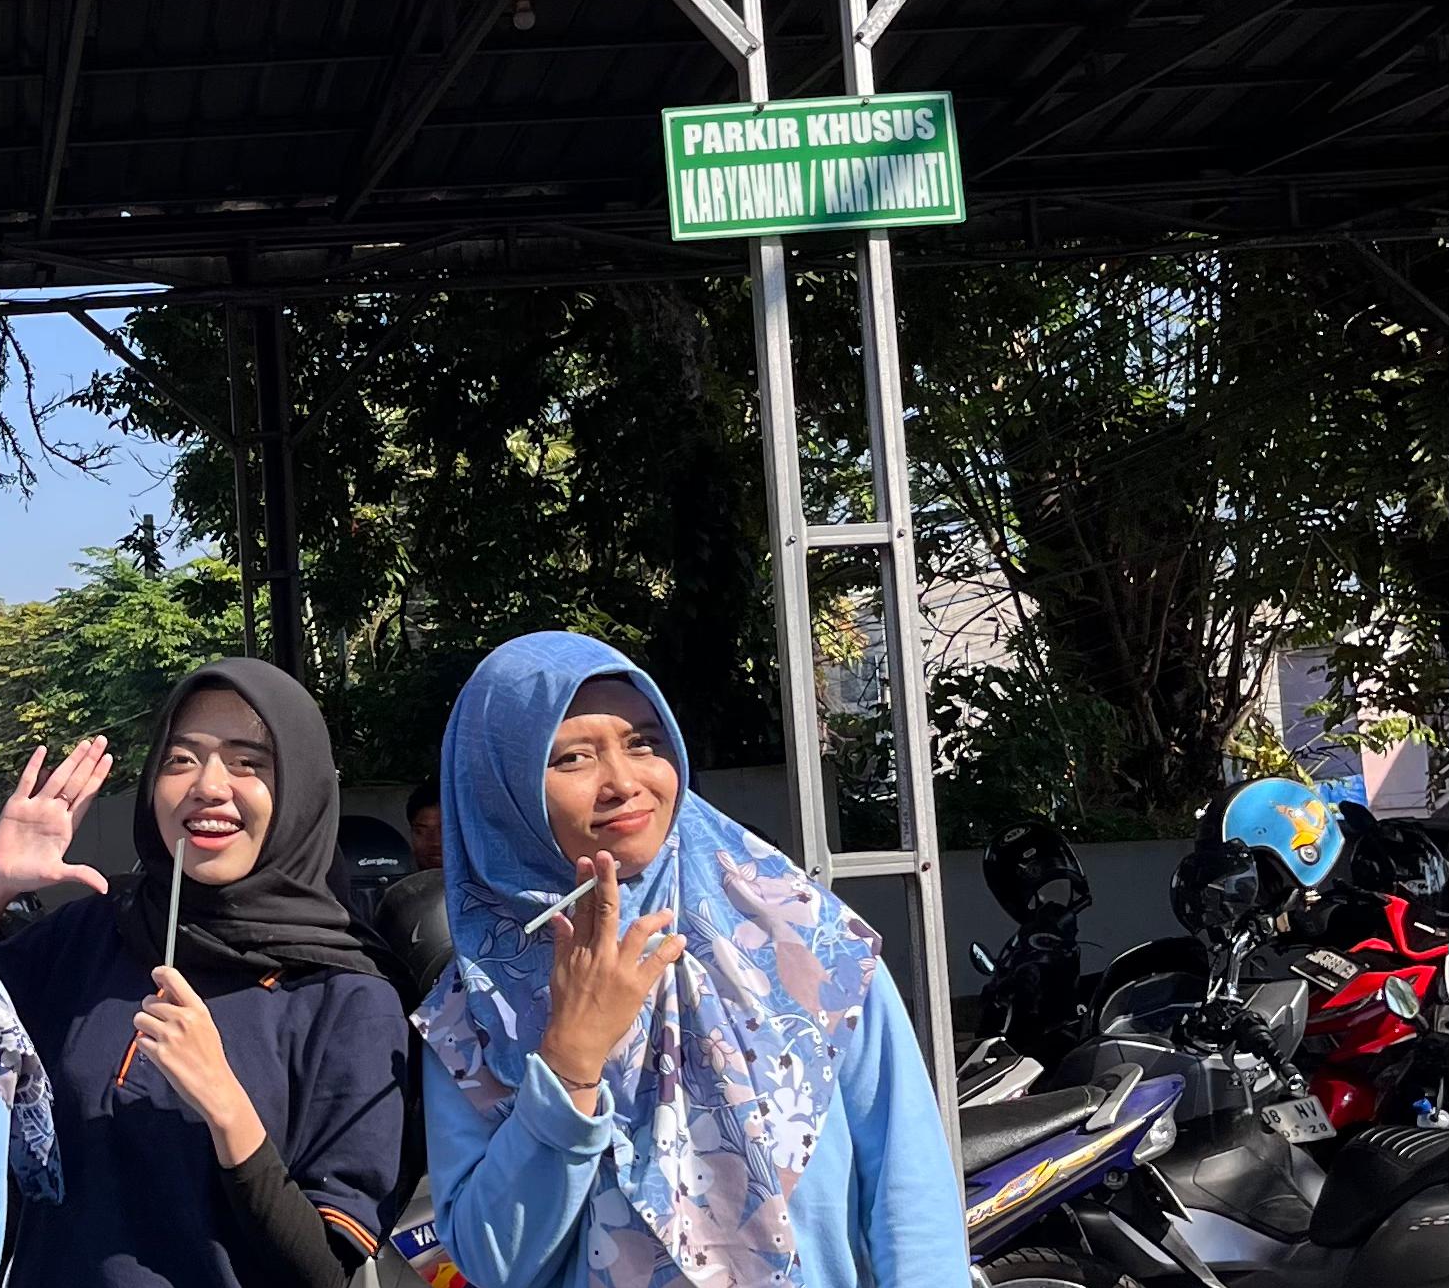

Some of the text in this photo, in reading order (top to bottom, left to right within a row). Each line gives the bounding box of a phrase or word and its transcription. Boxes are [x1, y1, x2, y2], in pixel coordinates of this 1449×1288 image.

[683, 107, 936, 156] PARKIR KHUSUS
[680, 161, 804, 224] KARYAWAN
[821, 151, 951, 214] KARYAWATI
